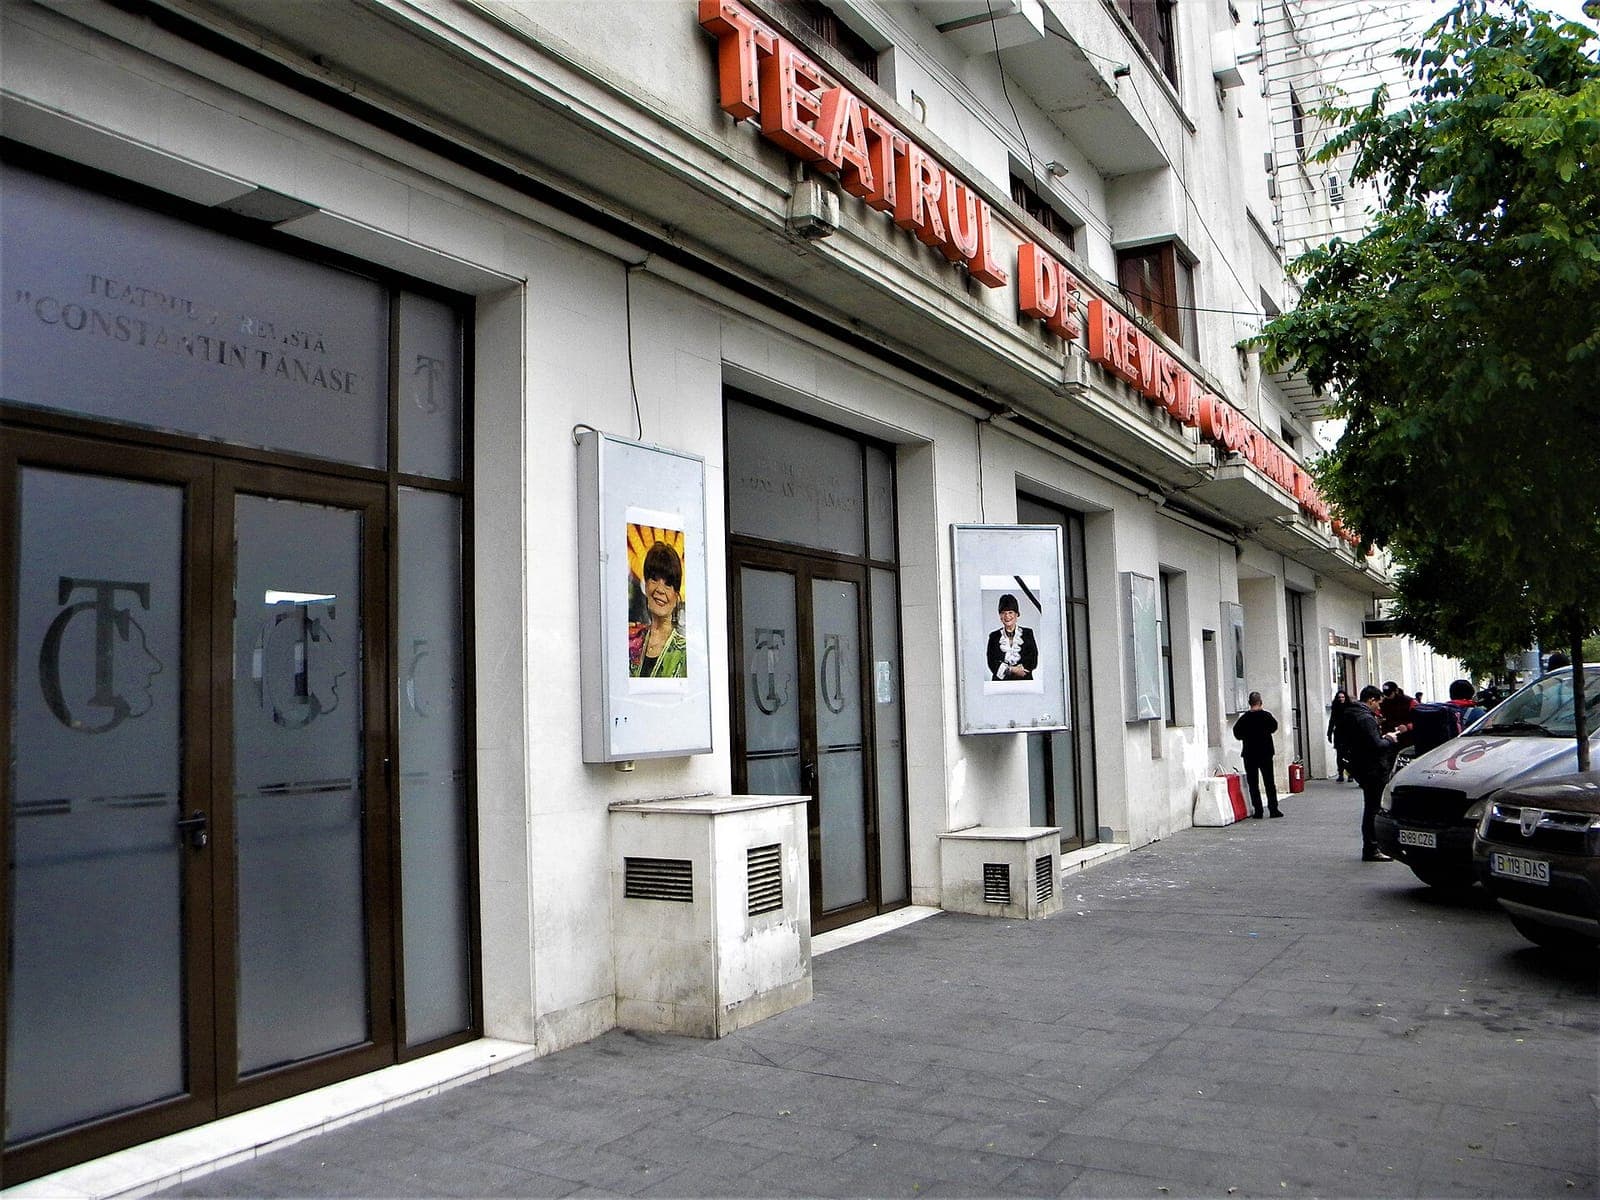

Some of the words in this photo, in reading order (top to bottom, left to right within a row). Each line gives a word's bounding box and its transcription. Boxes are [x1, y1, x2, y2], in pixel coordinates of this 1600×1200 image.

[699, 0, 1008, 288] TEATRUL
[1018, 242, 1080, 340] DE
[1088, 299, 1200, 428] REVISTA
[1497, 855, 1505, 871] B
[1508, 857, 1520, 874] 119
[1524, 859, 1547, 879] DAS
